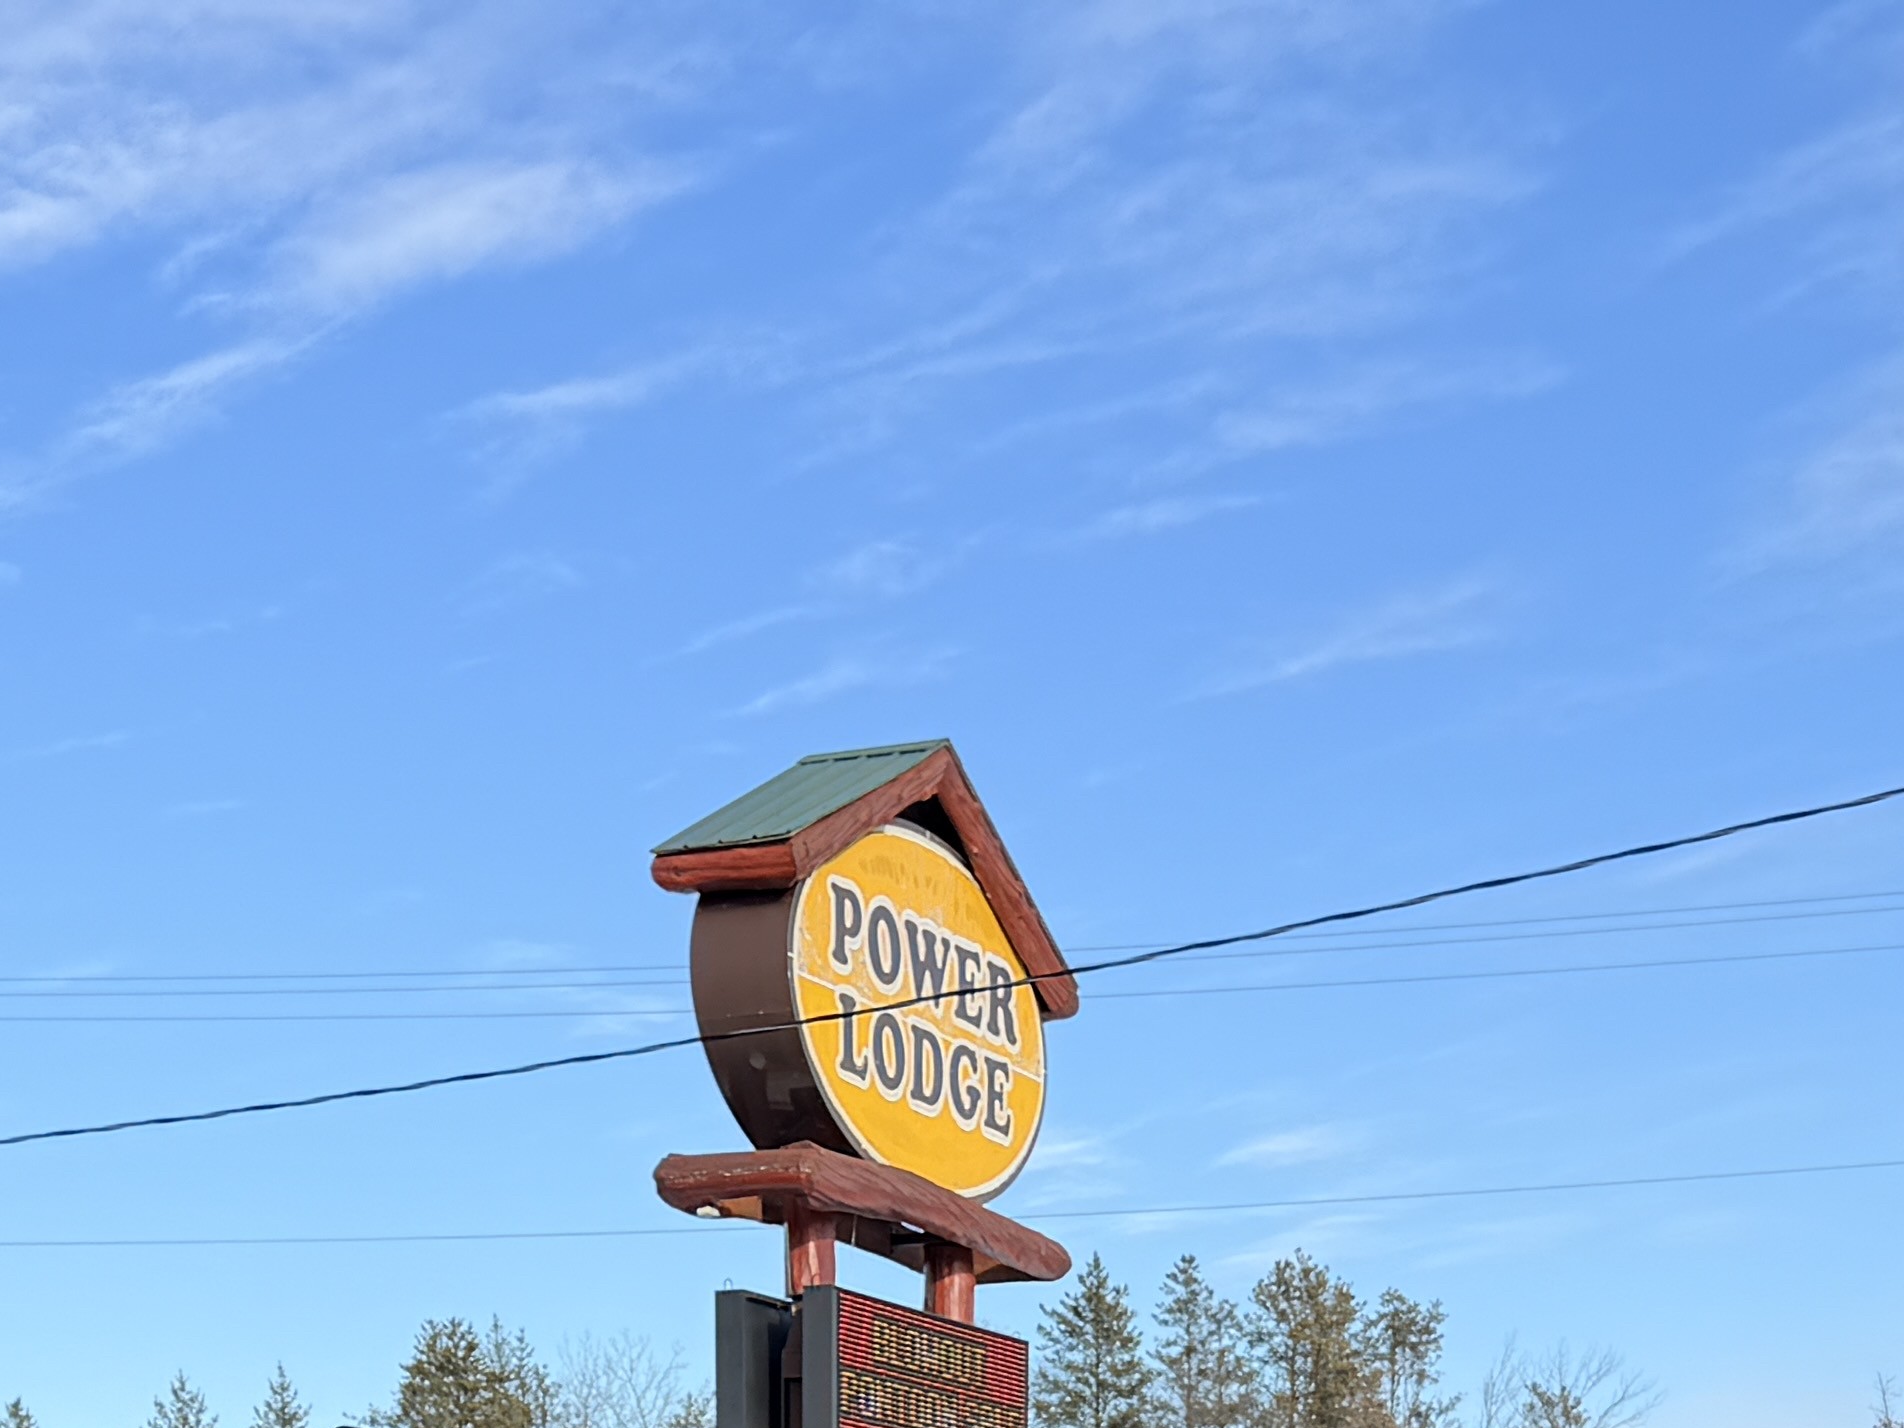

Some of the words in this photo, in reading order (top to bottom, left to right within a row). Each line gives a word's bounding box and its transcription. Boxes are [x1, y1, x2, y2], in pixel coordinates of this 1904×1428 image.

[829, 879, 1020, 1049] POWER
[838, 990, 1013, 1137] LODGE
[872, 1318, 987, 1390] BLOWOUT
